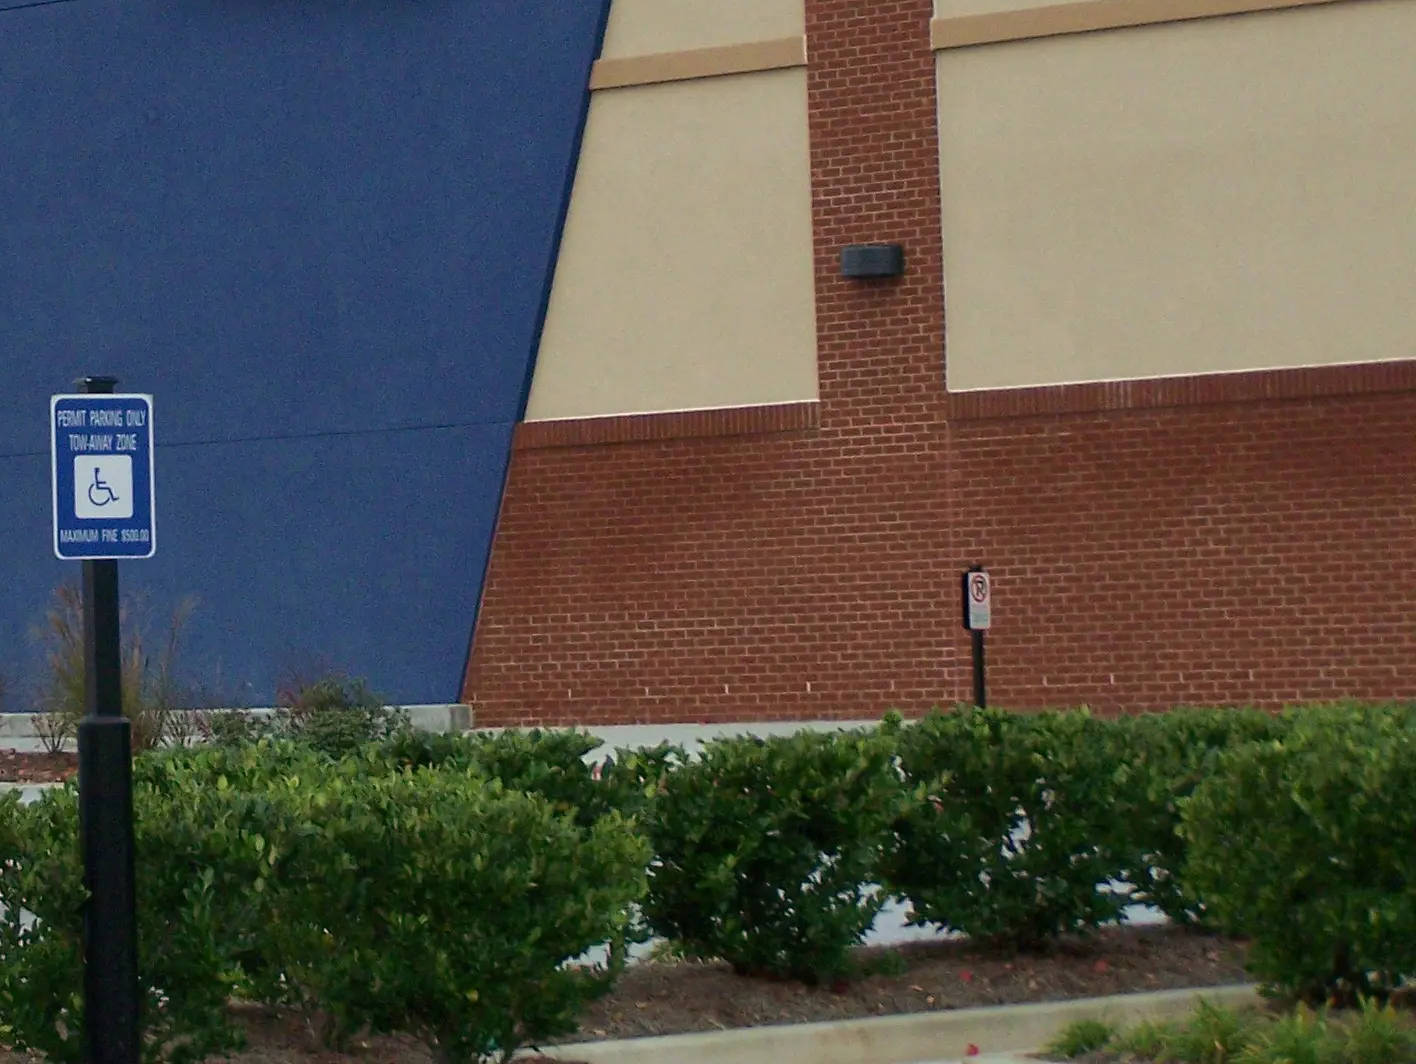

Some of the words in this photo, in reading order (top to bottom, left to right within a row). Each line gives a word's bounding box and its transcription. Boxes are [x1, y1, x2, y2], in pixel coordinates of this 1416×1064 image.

[56, 409, 87, 428] PERMIT
[89, 409, 124, 427] PARKING
[126, 408, 147, 427] ONLY
[68, 433, 114, 452] TOW-AWAY
[115, 433, 137, 451] ZONE
[59, 528, 99, 544] MAXIMUM
[101, 528, 119, 543] FINE
